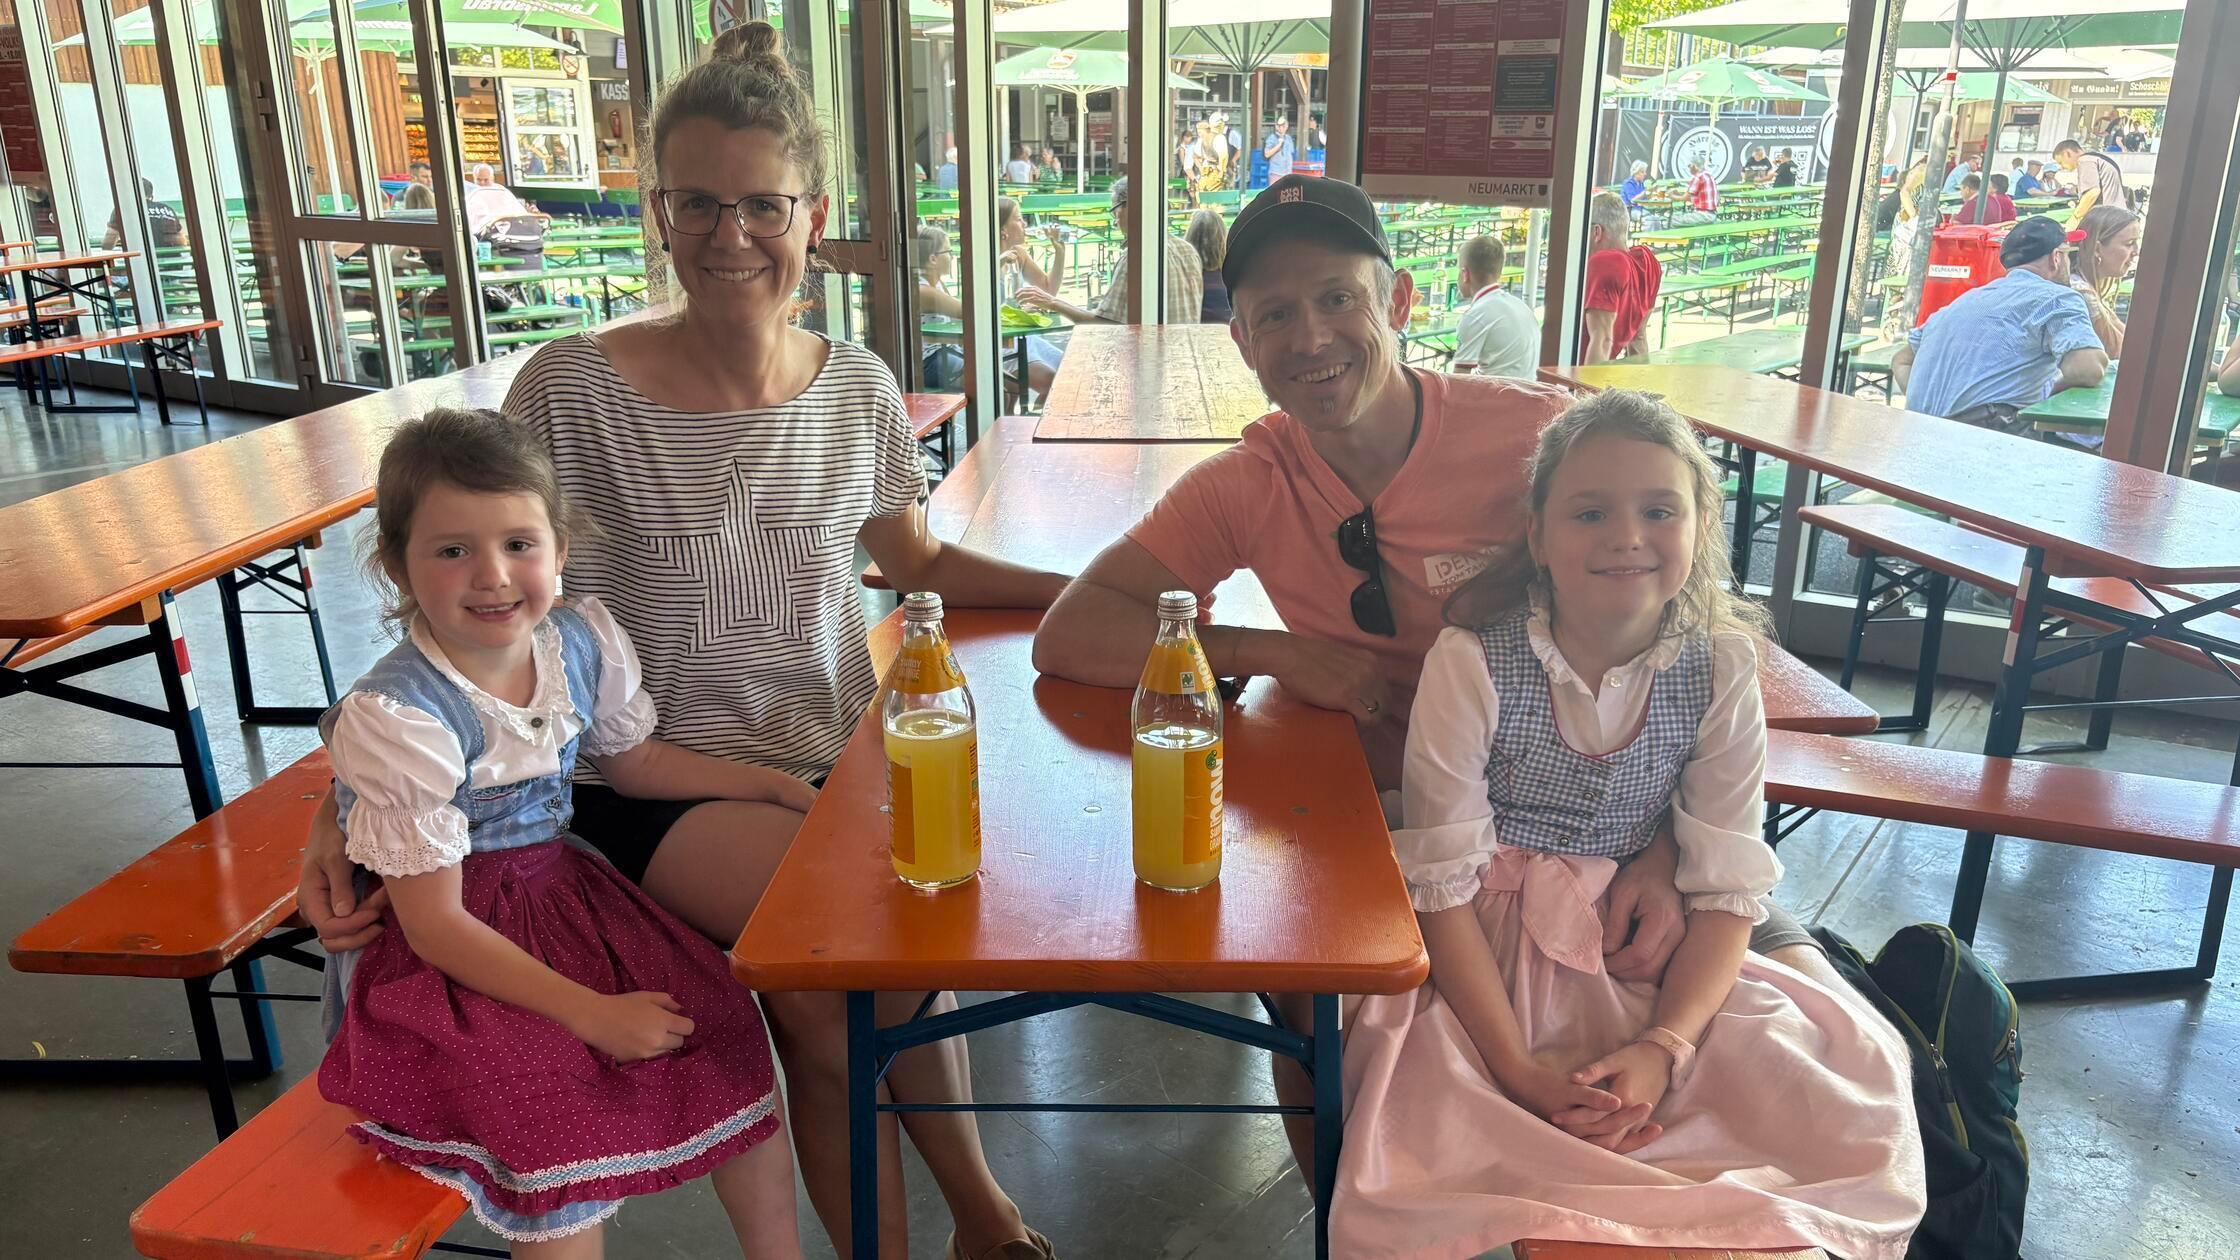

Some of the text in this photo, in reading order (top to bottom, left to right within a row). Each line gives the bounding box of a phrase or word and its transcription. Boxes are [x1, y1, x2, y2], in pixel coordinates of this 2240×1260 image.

[1739, 125, 1763, 134] WANN
[1763, 125, 1777, 134] IST
[1778, 125, 1796, 134] WAS
[1467, 182, 1536, 196] NEUMARKT
